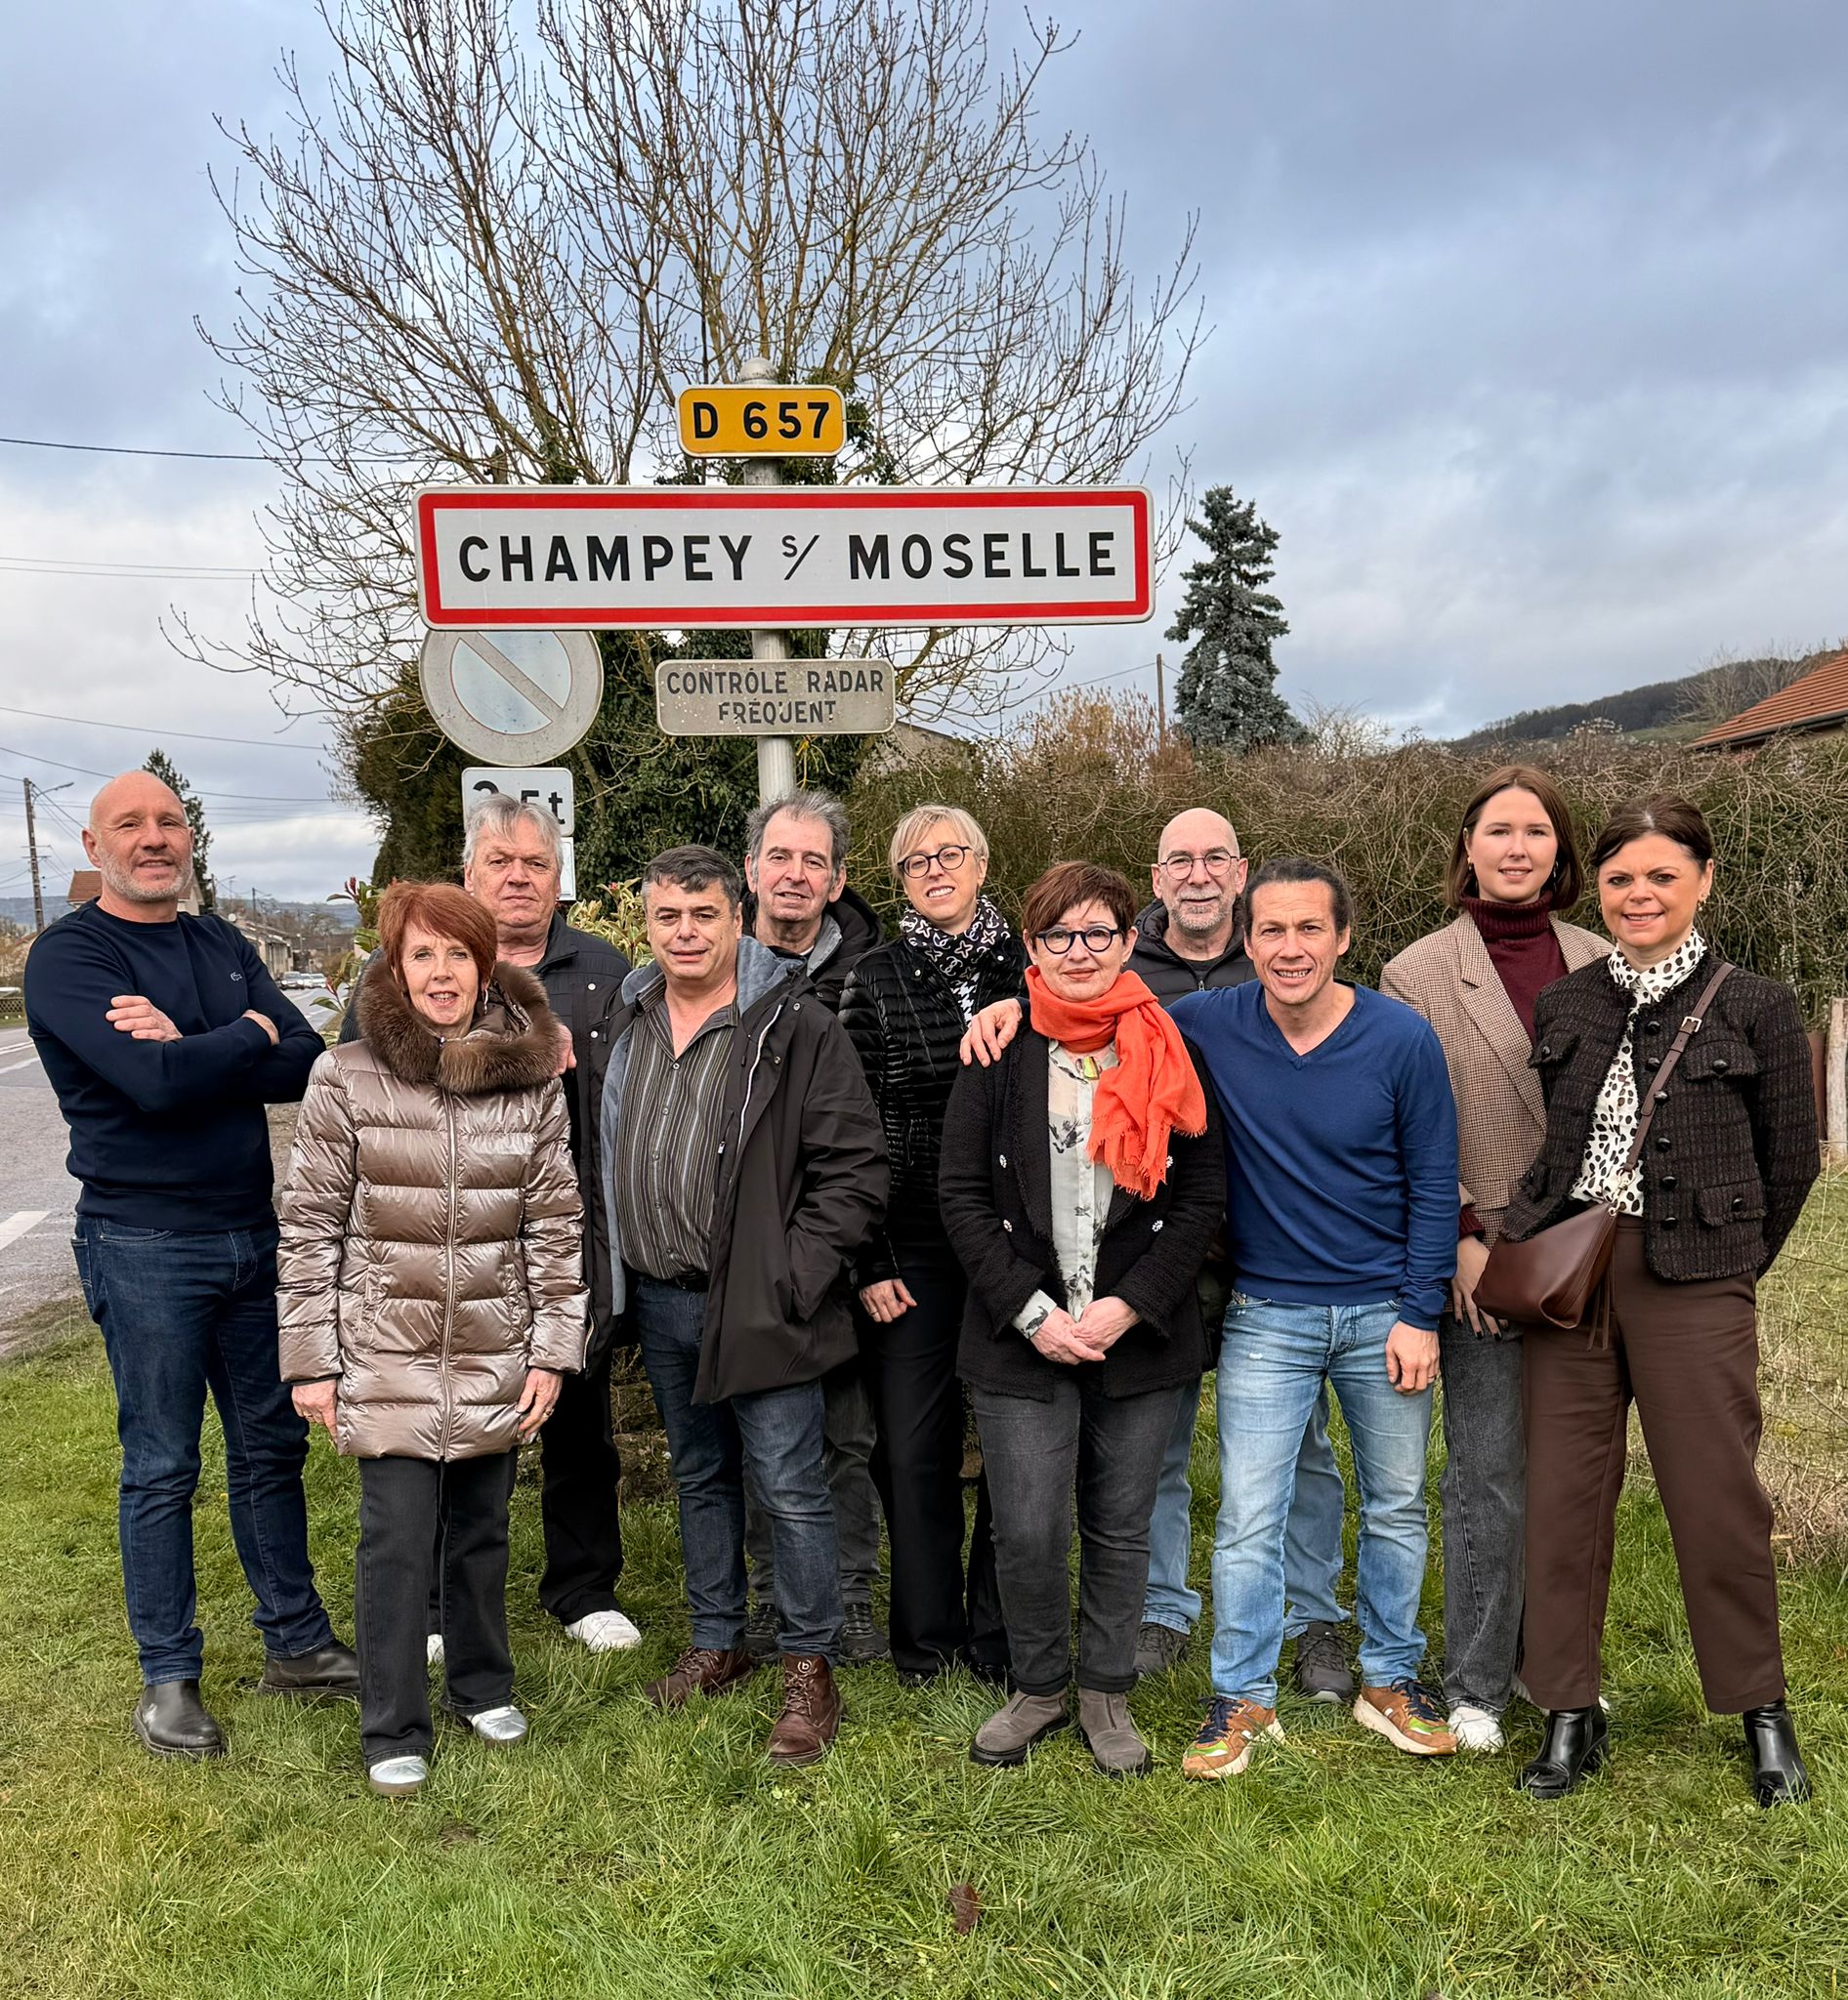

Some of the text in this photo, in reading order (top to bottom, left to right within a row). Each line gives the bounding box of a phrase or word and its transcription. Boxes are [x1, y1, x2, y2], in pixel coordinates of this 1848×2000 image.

[693, 401, 830, 439] D 657
[459, 534, 753, 582] CHAMPEY
[848, 531, 1116, 580] MOSELLE
[666, 667, 884, 694] CONTRÔLE RADAR
[718, 697, 837, 726] FRÉQUENT
